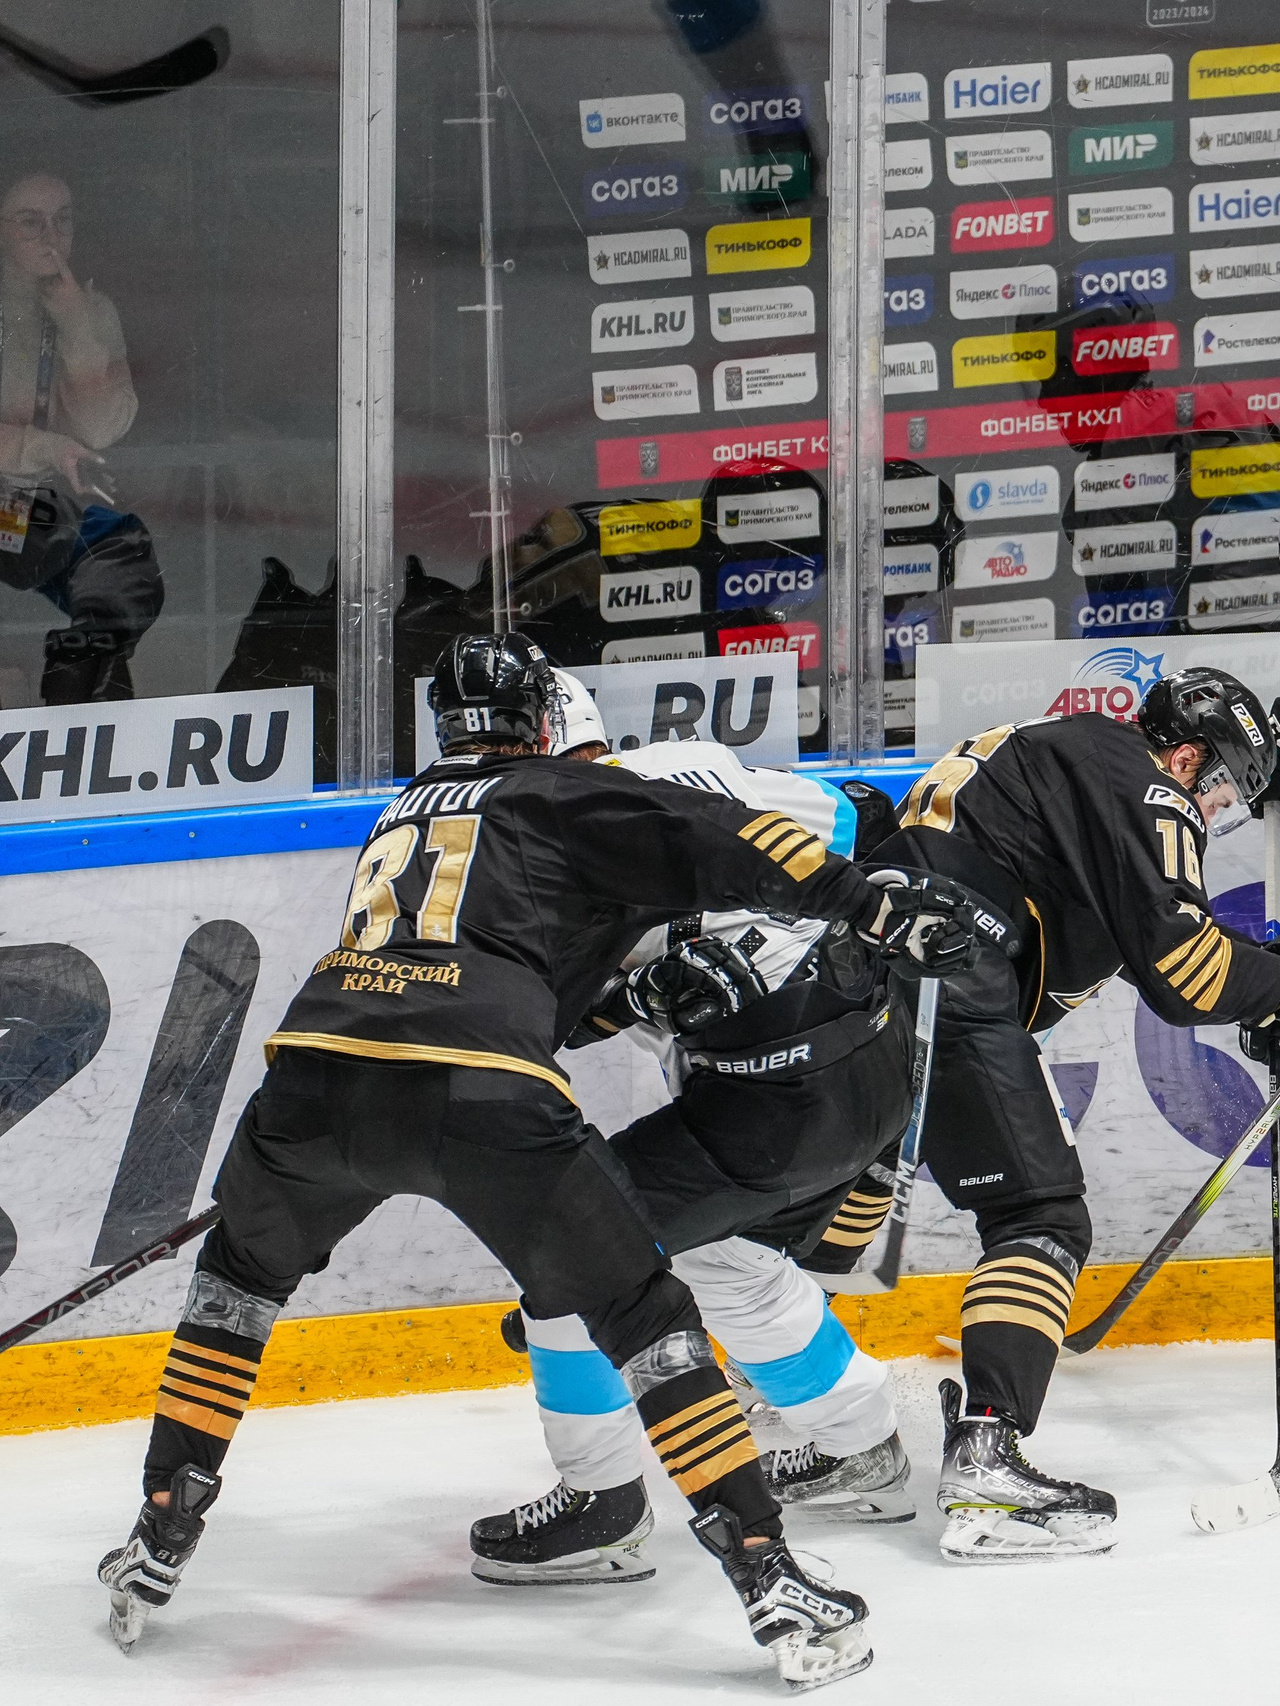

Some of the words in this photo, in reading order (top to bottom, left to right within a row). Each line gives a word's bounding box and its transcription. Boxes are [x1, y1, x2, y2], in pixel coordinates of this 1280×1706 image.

[1152, 5, 1210, 21] 2023/2024
[952, 74, 1042, 109] Haier
[1094, 71, 1170, 91] HCADMIRAL.RU
[606, 112, 679, 128] вконтакте
[709, 98, 802, 125] согаз
[1084, 133, 1158, 164] МИР
[591, 174, 679, 203] согаз
[719, 164, 794, 193] МИР
[954, 210, 1049, 240] FONBET
[613, 247, 688, 267] HCADMIRAL.RU
[714, 237, 803, 255] ТИНЬКОФФ
[955, 288, 999, 304] Яндекс
[1018, 283, 1051, 298] Плюс
[1081, 267, 1168, 296] согаз
[599, 311, 687, 339] KHL.RU
[960, 349, 1047, 368] ТИНЬКОФФ
[1075, 333, 1175, 363] FONBET
[980, 411, 1073, 438] ФОНБЕТ
[1077, 406, 1122, 429] КХЛ
[712, 438, 806, 464] ФОНБЕТ
[998, 479, 1049, 499] slavda
[1080, 479, 1121, 495] Яндекс
[1138, 471, 1169, 486] Плюс
[607, 518, 693, 536] ТИНЬКОФФ
[1099, 537, 1174, 559] HCADMIRAL.RU
[983, 555, 1013, 570] АВТО
[990, 565, 1029, 580] РАДИО
[607, 580, 692, 608] KHL.RU
[724, 569, 815, 597] согаз
[1077, 599, 1166, 628] согаз
[1044, 685, 1134, 717] АВТО
[463, 707, 491, 732] 81
[1155, 818, 1202, 890] 16
[340, 814, 482, 952] 81
[885, 917, 911, 945] CCM
[313, 950, 463, 987] ПРИМОРСКИЙ
[341, 973, 408, 995] КРАЙ
[889, 1158, 916, 1224] CCM
[187, 1470, 216, 1486] CCM
[694, 1510, 720, 1530] CCM
[154, 1548, 179, 1565] 81
[778, 1582, 845, 1622] CCM
